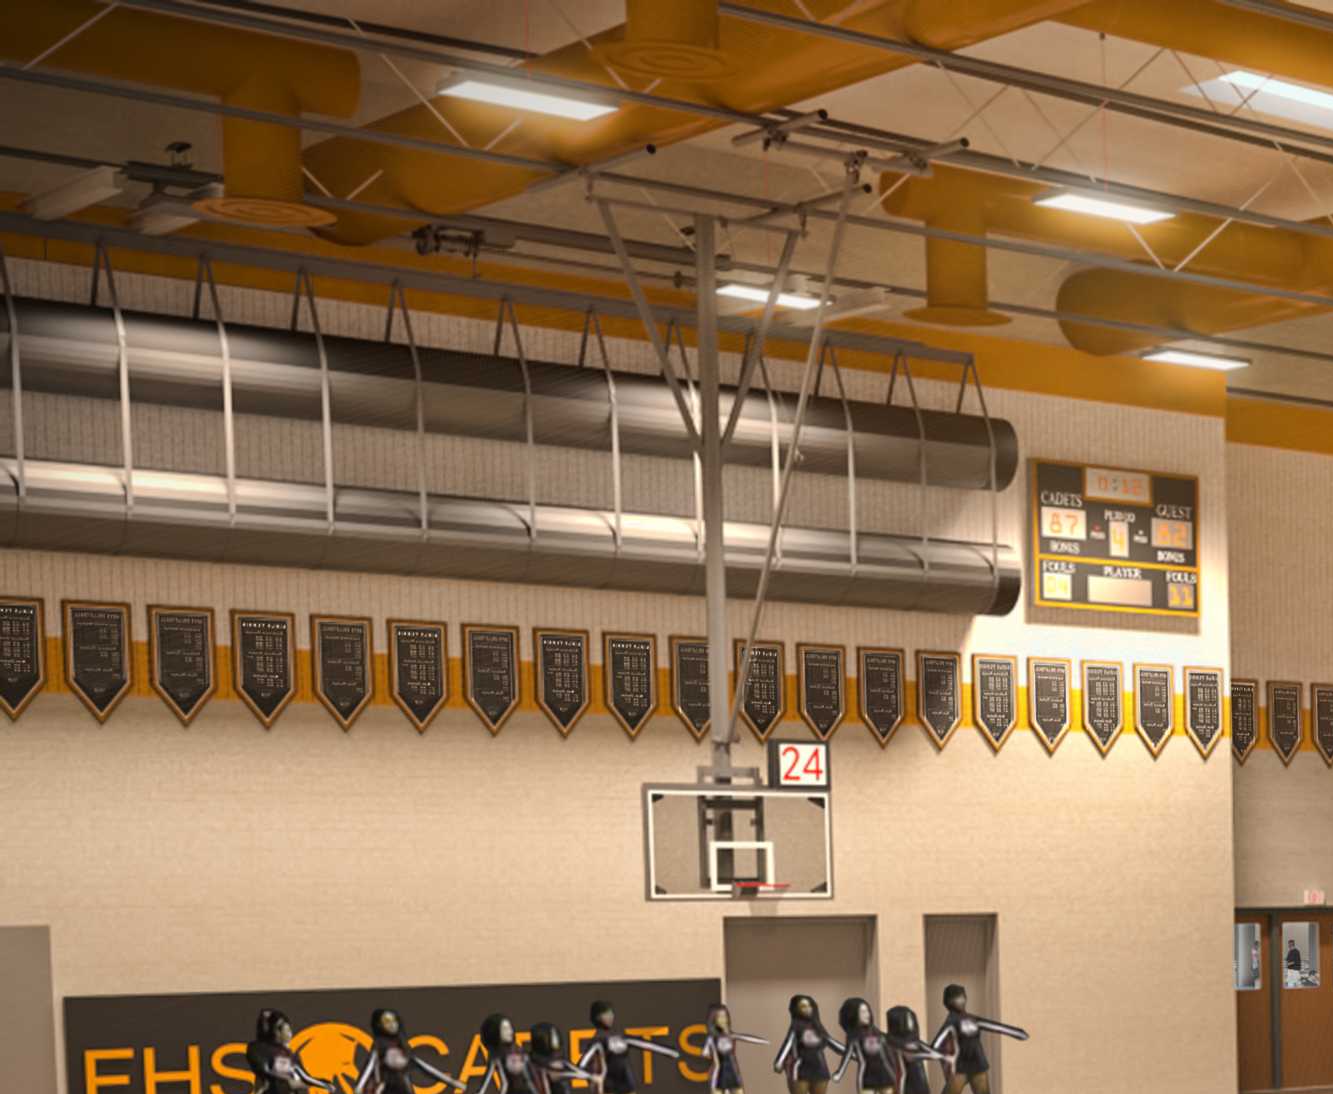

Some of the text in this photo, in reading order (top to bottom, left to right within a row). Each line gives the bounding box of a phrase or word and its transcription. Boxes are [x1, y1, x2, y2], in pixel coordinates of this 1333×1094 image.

[1041, 490, 1083, 508] CADETS
[1156, 504, 1192, 520] GUEST
[1049, 511, 1079, 534] 87
[1110, 527, 1126, 553] 4
[1104, 566, 1142, 580] PLAYER
[782, 746, 823, 781] 24
